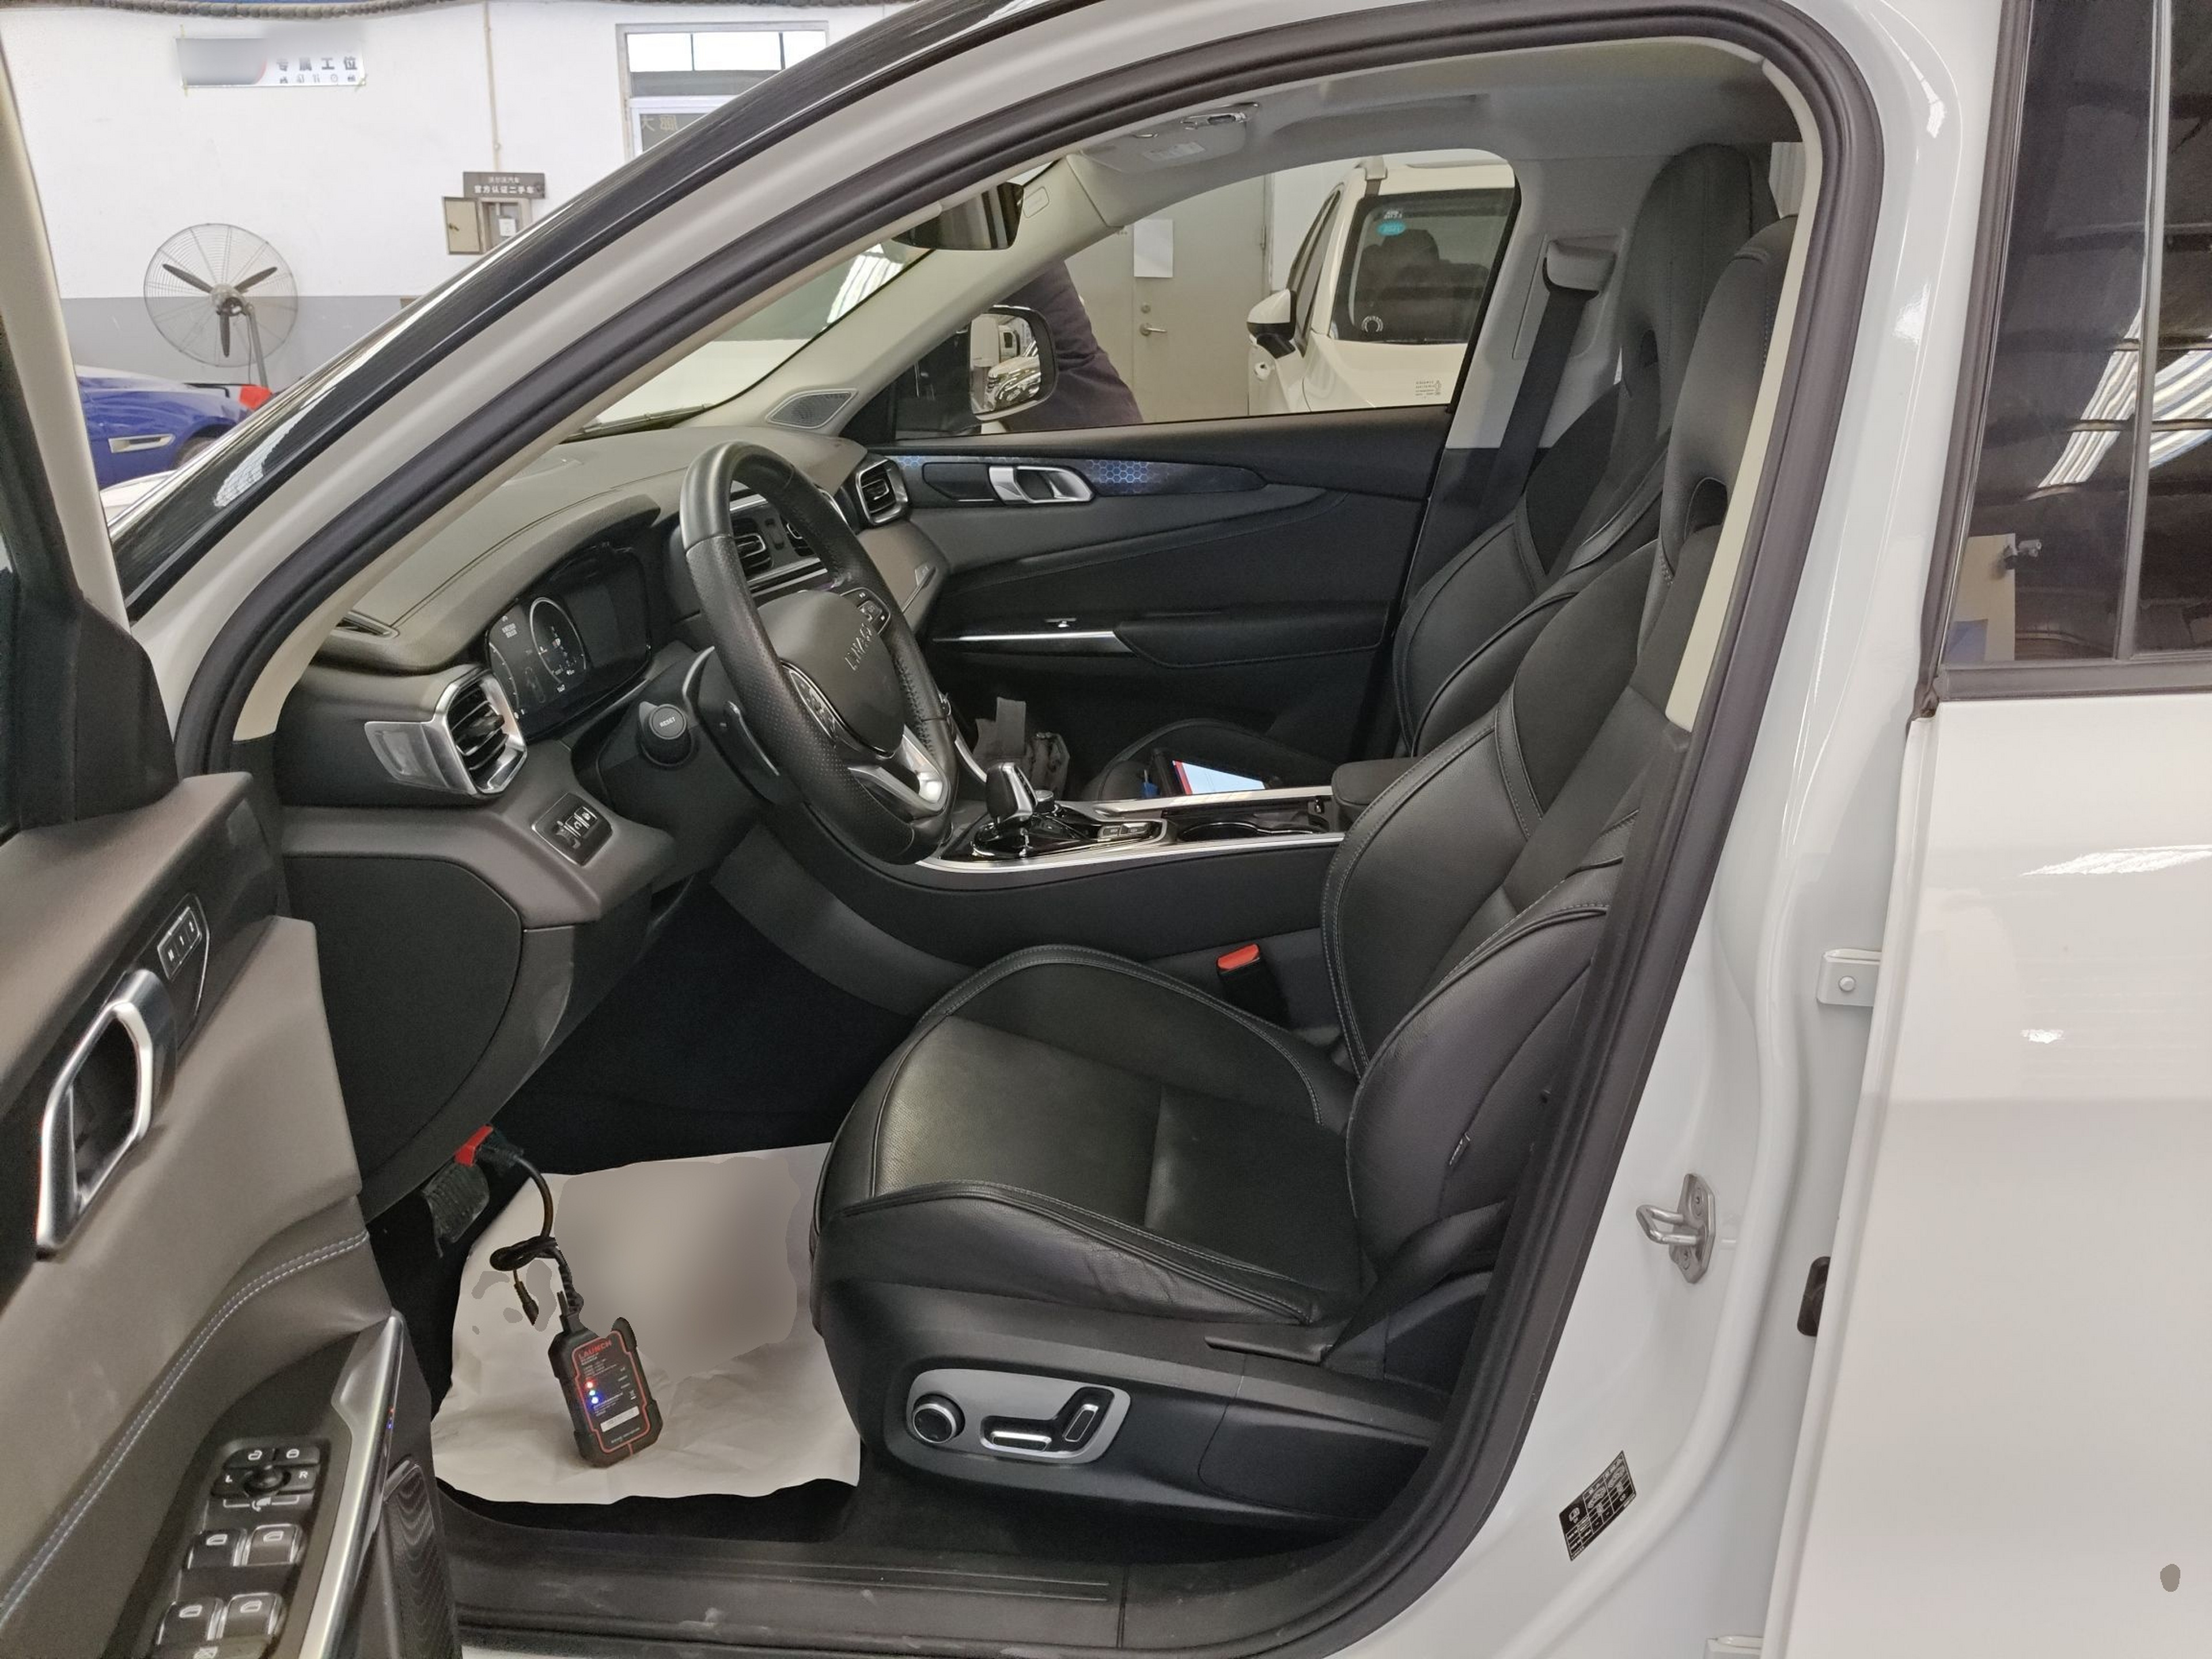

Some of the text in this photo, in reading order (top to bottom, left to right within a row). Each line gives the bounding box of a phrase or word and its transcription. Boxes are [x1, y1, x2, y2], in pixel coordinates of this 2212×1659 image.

[660, 717, 676, 728] RESET
[578, 1339, 612, 1358] LAUNCH
[225, 1475, 233, 1483] L
